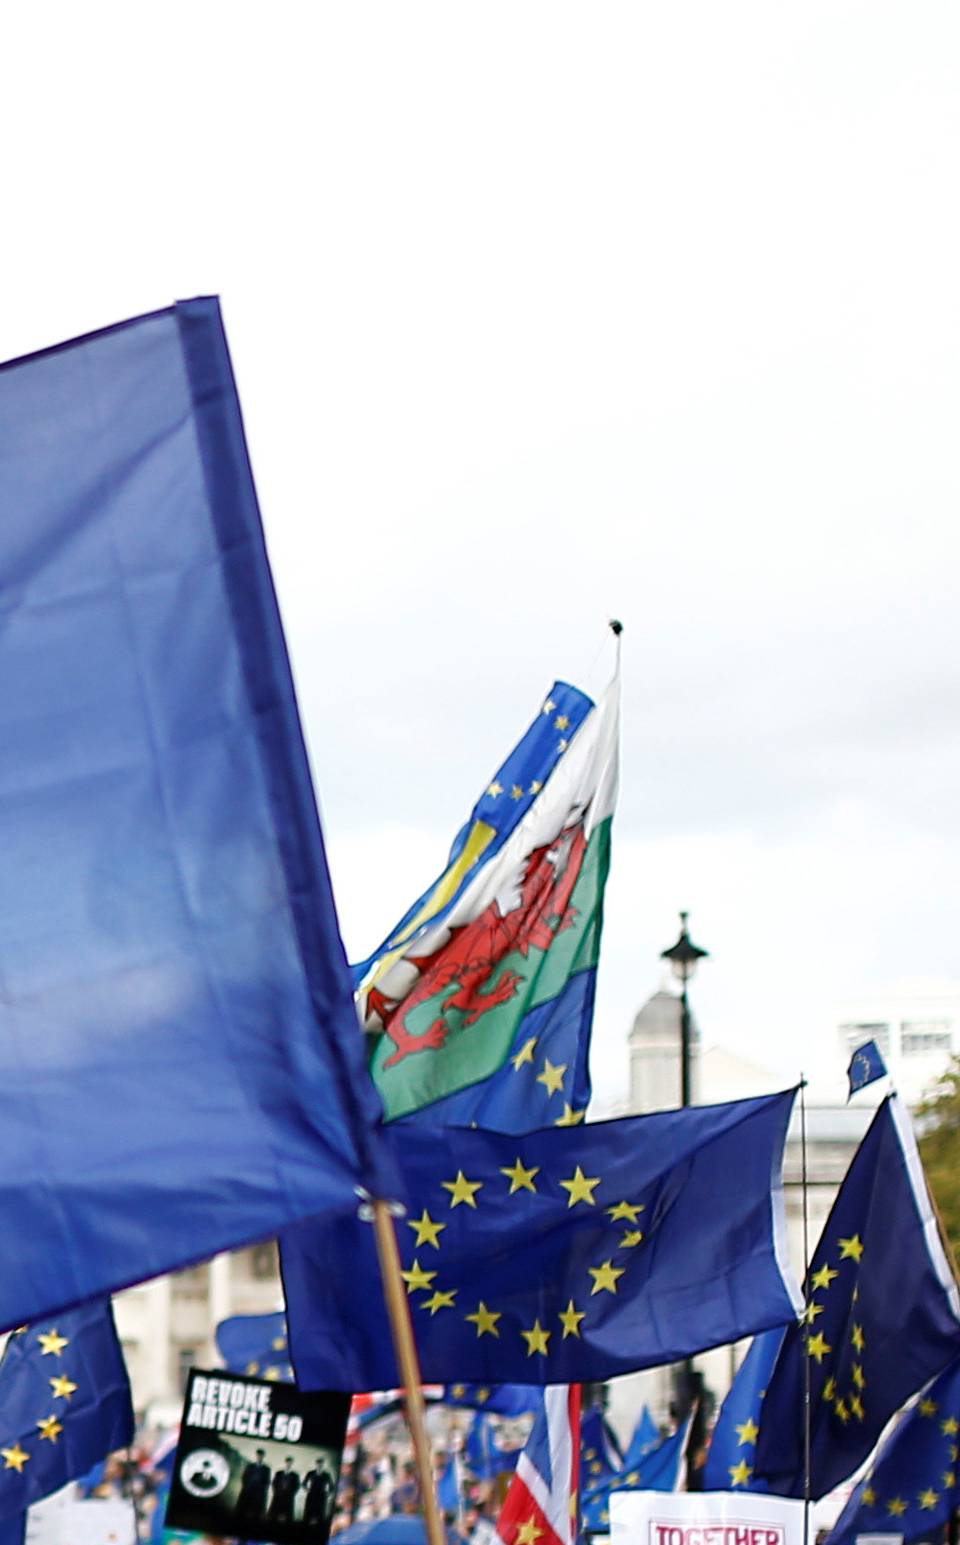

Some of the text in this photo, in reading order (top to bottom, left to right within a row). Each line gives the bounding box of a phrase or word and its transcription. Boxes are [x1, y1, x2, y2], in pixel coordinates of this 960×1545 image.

[191, 1376, 271, 1412] REVOKE
[188, 1403, 303, 1442] ARTICLE 50
